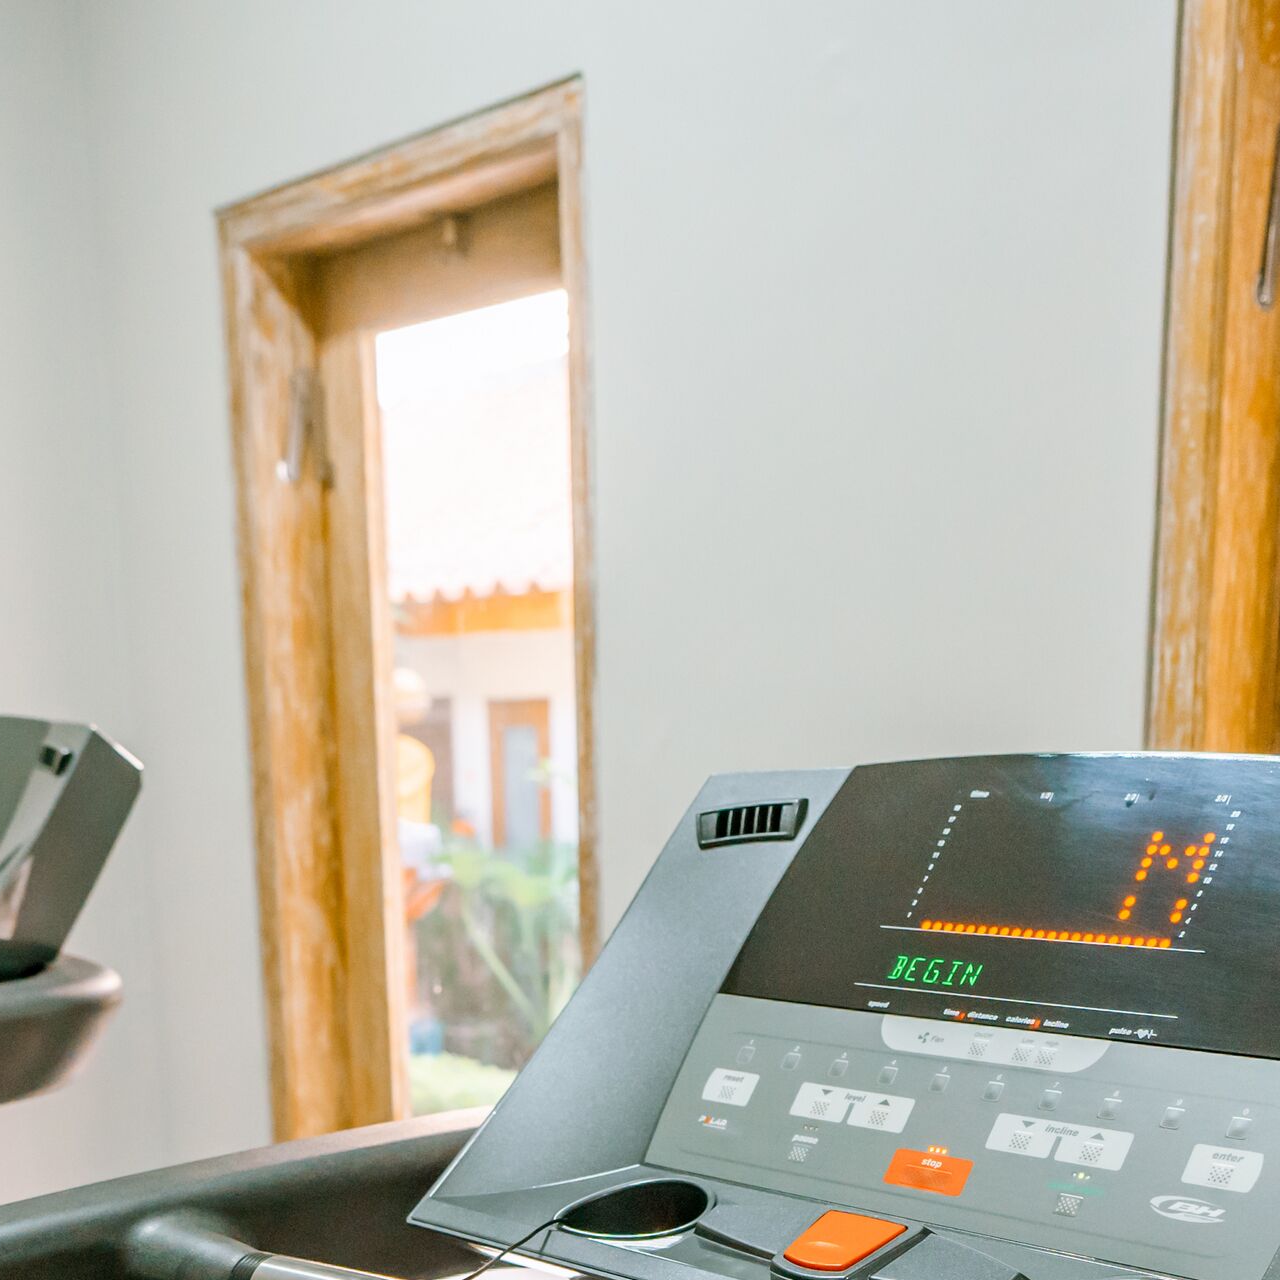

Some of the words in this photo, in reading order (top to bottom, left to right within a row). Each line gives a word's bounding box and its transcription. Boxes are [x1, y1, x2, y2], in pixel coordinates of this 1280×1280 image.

[888, 955, 983, 987] BEGIN
[1108, 1027, 1132, 1036] pulse
[845, 1092, 867, 1103] level
[1045, 1124, 1080, 1138] incline
[921, 1158, 943, 1169] stop
[1212, 1151, 1245, 1164] enter
[1168, 1201, 1227, 1217] BH
